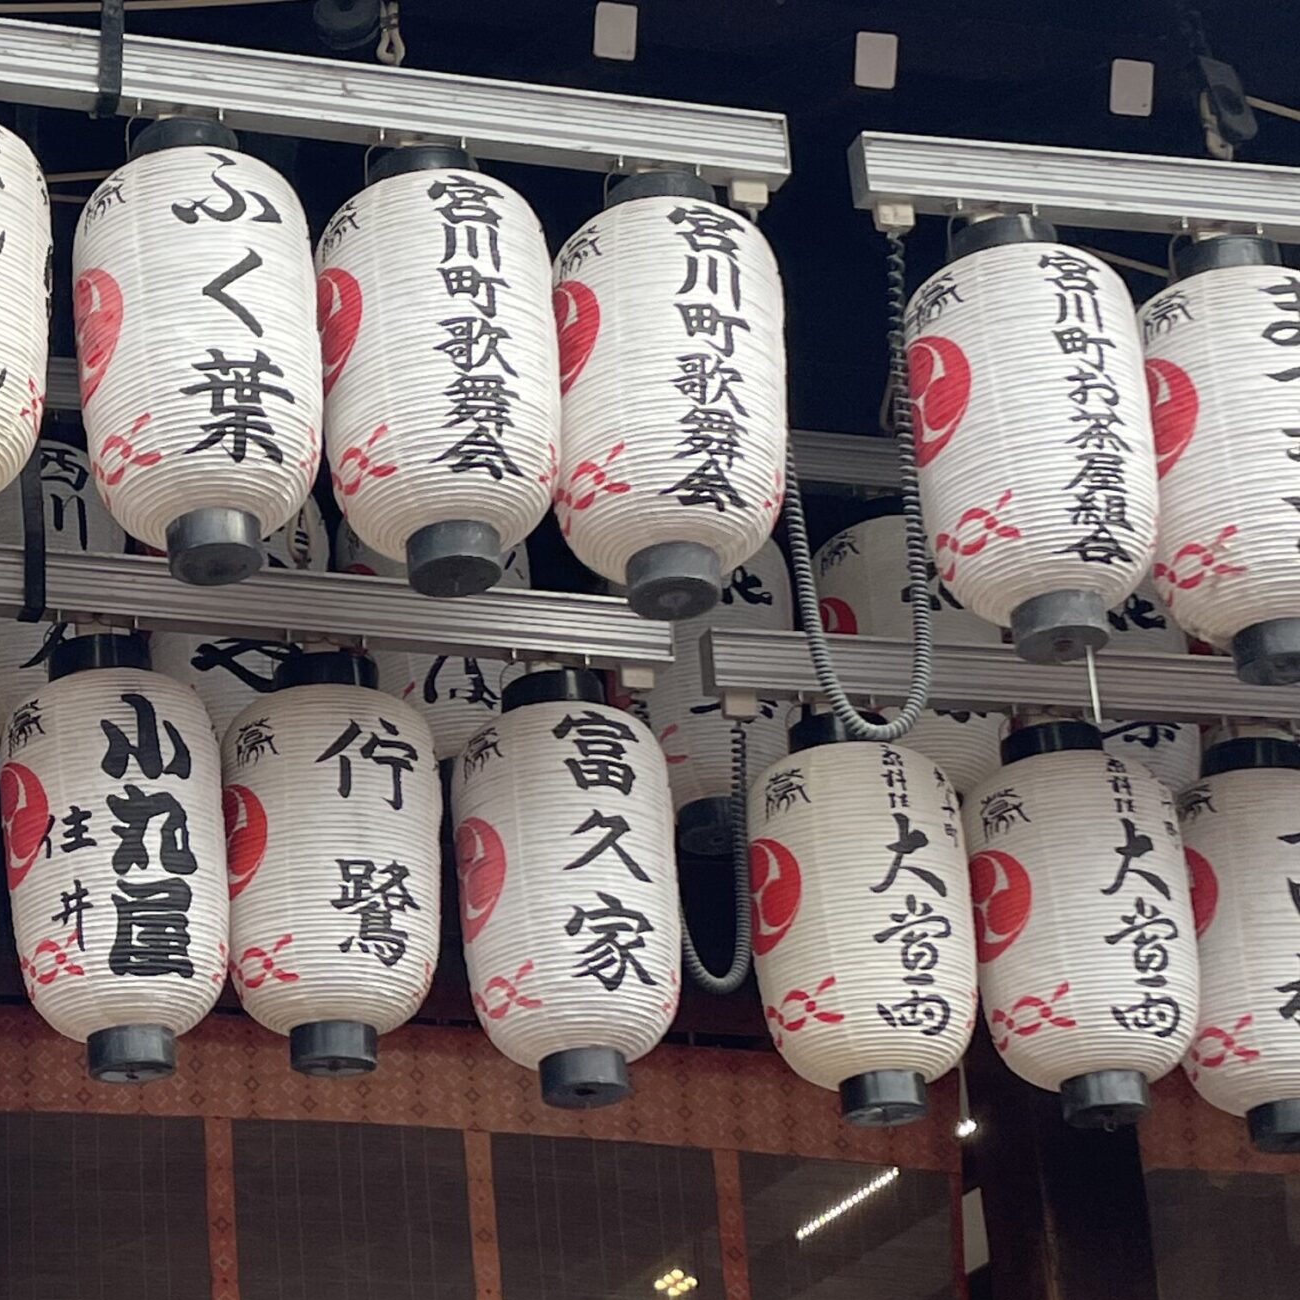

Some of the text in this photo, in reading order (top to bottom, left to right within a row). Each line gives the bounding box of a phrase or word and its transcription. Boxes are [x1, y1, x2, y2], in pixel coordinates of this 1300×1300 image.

[172, 153, 294, 463] ふく葉
[428, 175, 523, 480] 宮川町歌舞会
[660, 205, 751, 511] 宮川町歌舞会
[1038, 252, 1134, 564] 宮川町お茶屋組合
[40, 806, 97, 951] 住井
[101, 694, 198, 977] 小丸屋
[552, 711, 657, 991] 富久家
